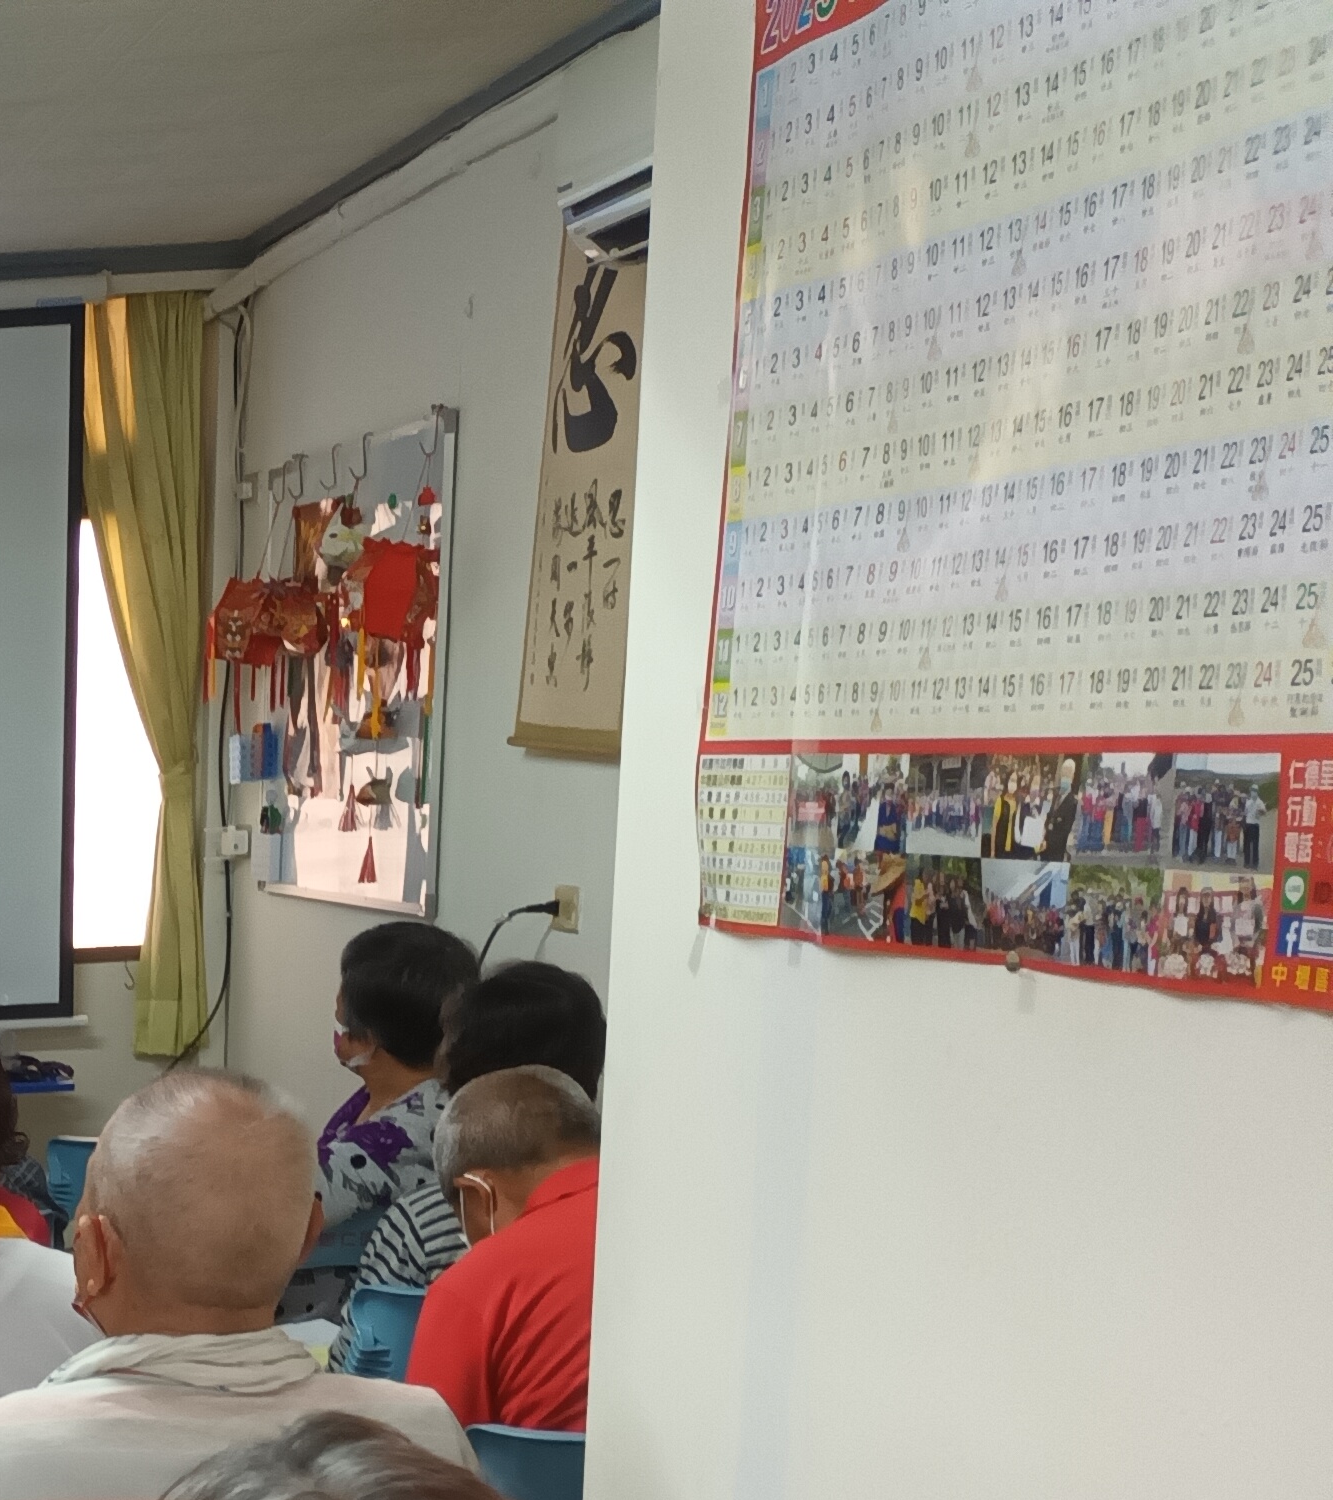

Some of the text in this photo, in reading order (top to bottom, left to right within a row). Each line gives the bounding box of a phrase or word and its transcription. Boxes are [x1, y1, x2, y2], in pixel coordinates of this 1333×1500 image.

[805, 2, 1063, 134] 3 4 6 8 9 10 13 14
[808, 23, 876, 74] 3 4 5 6
[781, 60, 1087, 202] 2 3 4 6 8 9 10 12 13 14 15
[798, 100, 1161, 253] 3 12 13 14 18
[773, 174, 1155, 317] 2 3 4 8 10 11 12 13 15 17 18
[767, 410, 774, 430] 2
[789, 405, 797, 426] 3
[845, 391, 854, 412] 6
[920, 371, 933, 394] 10
[946, 365, 958, 388] 11
[1095, 326, 1112, 352] 17
[1127, 319, 1141, 344] 18
[1293, 274, 1311, 303] 24
[770, 263, 1089, 374] 2 3 6 12 16
[763, 353, 1303, 486] 2 3 7 8 16 17 18 24
[759, 522, 767, 542] 2
[832, 510, 840, 530] 6
[854, 506, 862, 526] 7
[876, 503, 885, 524] 8
[1112, 462, 1126, 486] 18
[1249, 436, 1267, 464] 23
[1309, 425, 1329, 454] 25
[756, 578, 764, 597] 2
[777, 575, 784, 595] 3
[1043, 540, 1058, 563] 16
[1104, 532, 1119, 557] 18
[1239, 512, 1257, 540] 23
[1269, 510, 1287, 537] 24
[1302, 504, 1323, 532] 25
[753, 632, 761, 652] 2
[774, 630, 781, 651] 3
[822, 626, 829, 646] 6
[857, 623, 866, 644] 8
[1037, 606, 1051, 629] 16
[1067, 604, 1082, 627] 17
[1149, 596, 1164, 622] 20
[1203, 591, 1220, 618] 22
[1232, 588, 1248, 615] 23
[1261, 586, 1278, 613] 24
[1296, 583, 1319, 610] 25
[751, 687, 758, 706] 2
[770, 686, 777, 706] 3
[852, 682, 859, 703] 8
[1030, 673, 1045, 696] 16
[1199, 664, 1215, 690] 22
[1254, 661, 1272, 688] 24
[1291, 659, 1314, 686] 25
